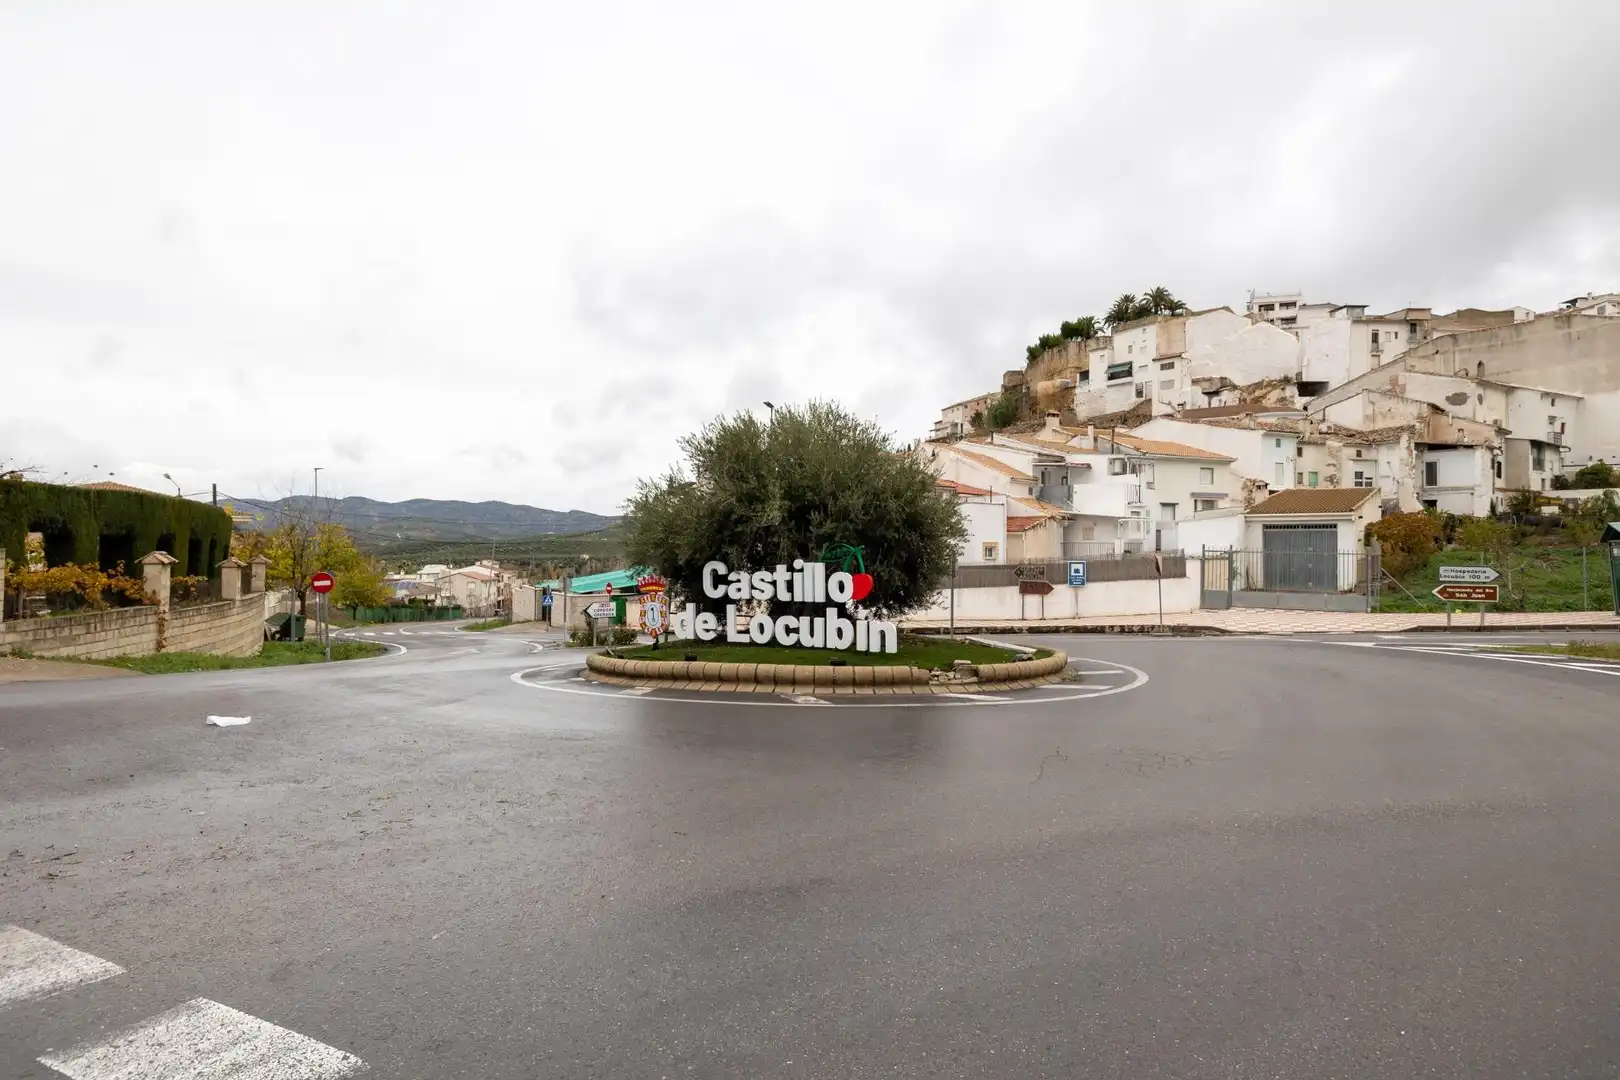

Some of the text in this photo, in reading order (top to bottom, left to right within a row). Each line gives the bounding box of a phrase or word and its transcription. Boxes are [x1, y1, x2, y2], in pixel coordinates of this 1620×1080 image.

[702, 559, 854, 603] Castillo
[674, 602, 898, 653] de Locubín
